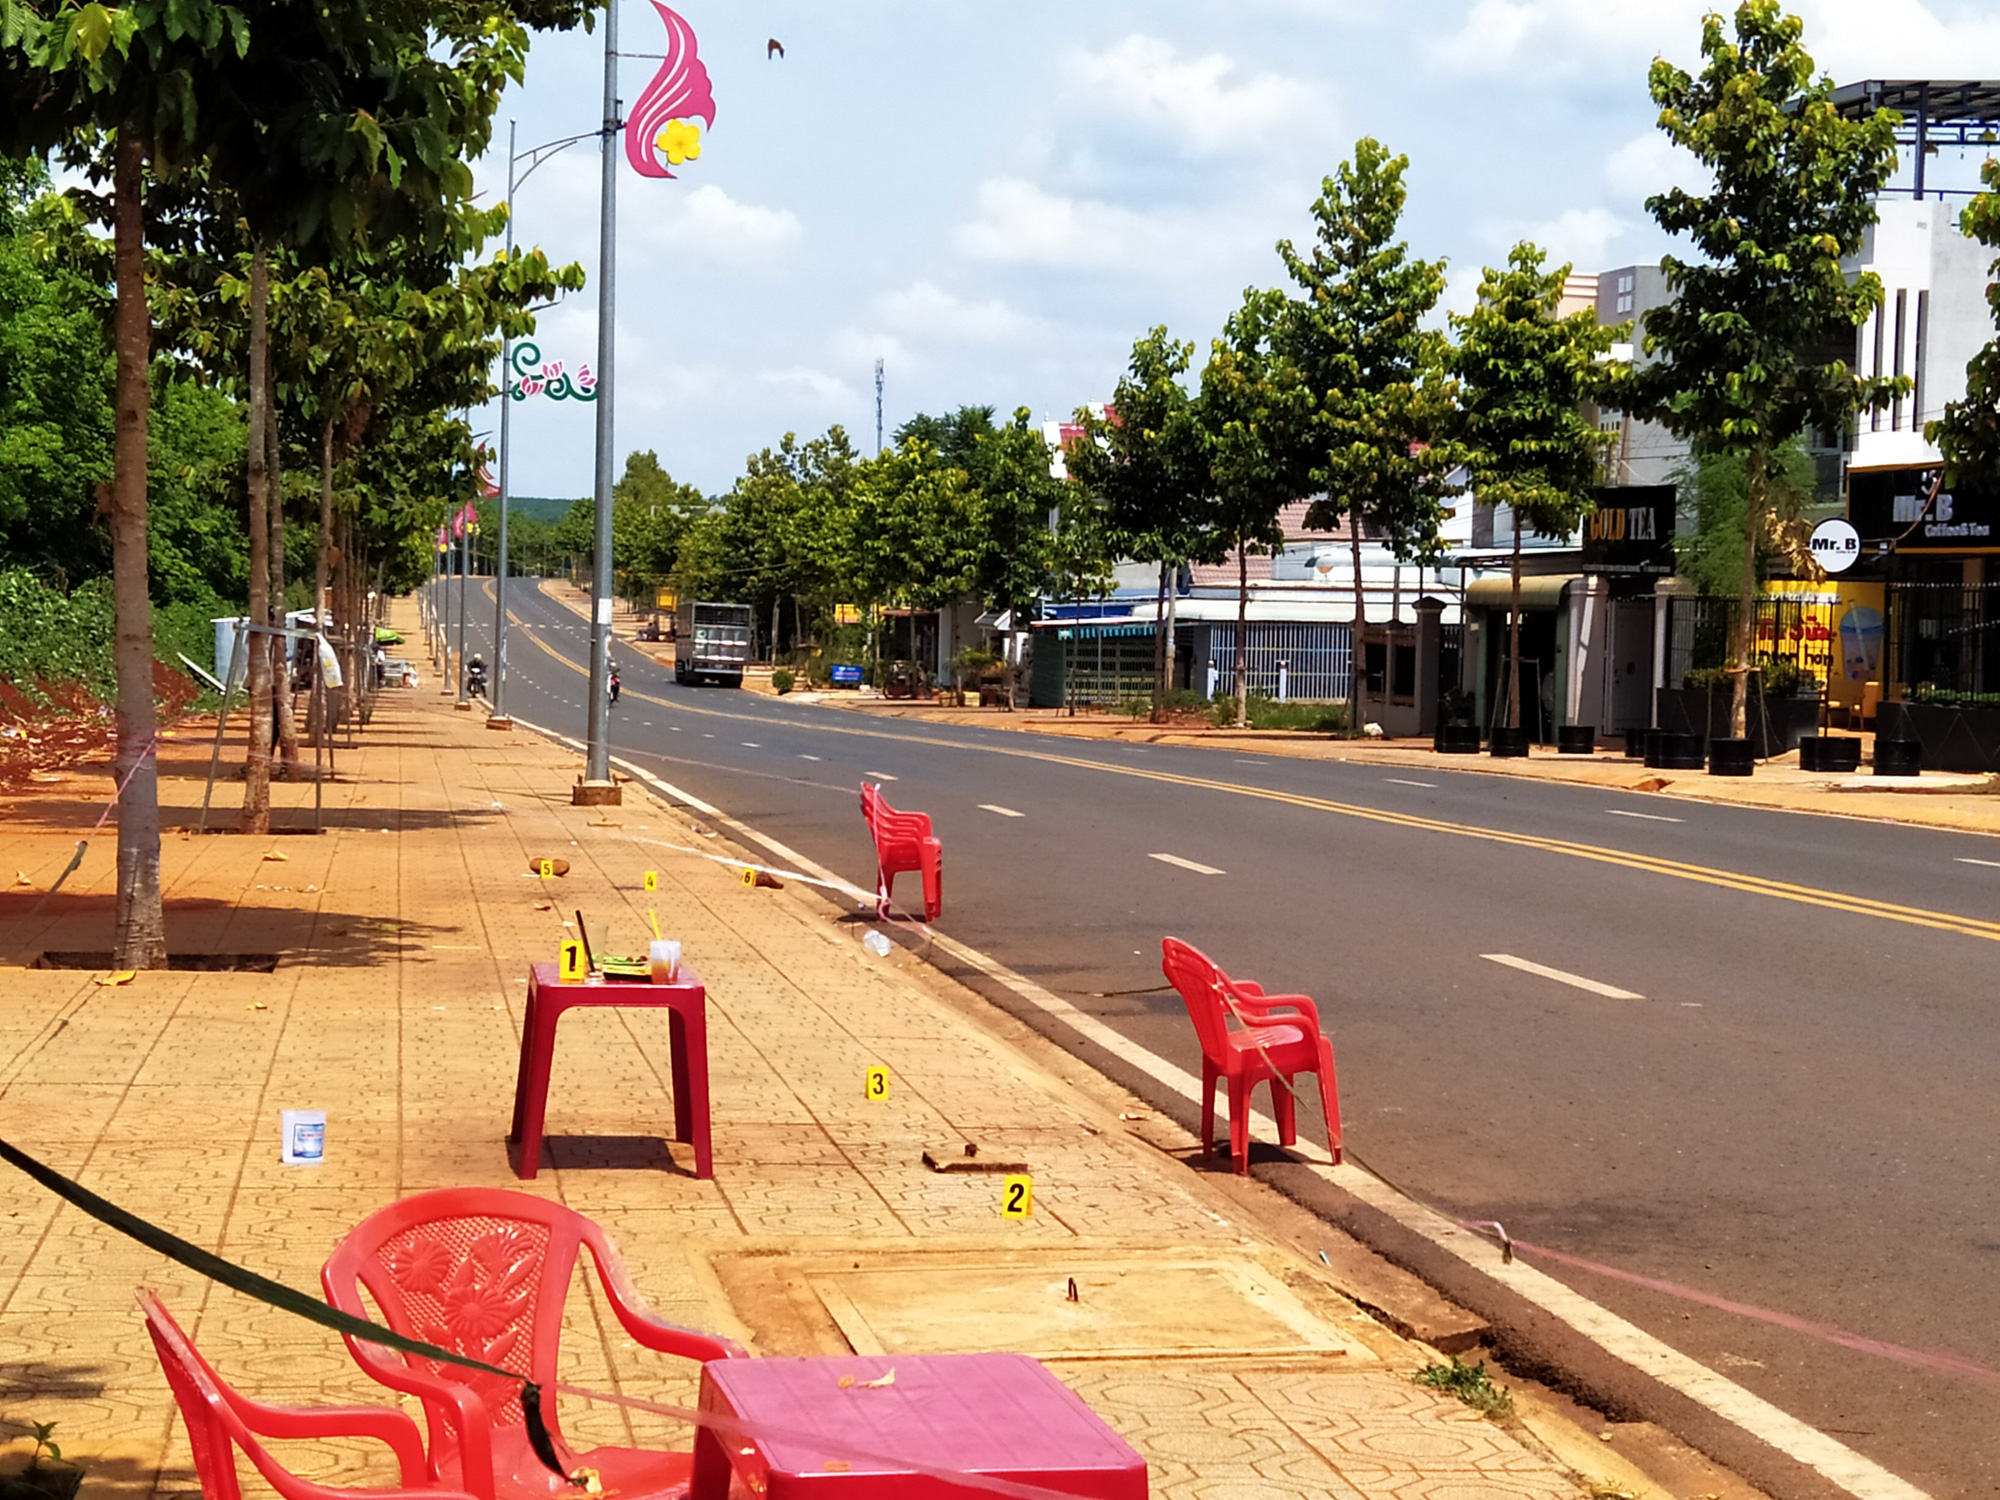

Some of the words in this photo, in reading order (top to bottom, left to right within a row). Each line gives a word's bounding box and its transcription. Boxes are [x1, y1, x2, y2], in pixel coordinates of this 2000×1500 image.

[1589, 507, 1626, 540] GOLD
[1628, 507, 1656, 540] TEA
[1812, 538, 1840, 550] Mr.
[1845, 538, 1856, 550] B
[543, 864, 551, 875] 5
[744, 871, 751, 883] 6
[647, 876, 654, 887] 4
[565, 945, 577, 972] 1
[873, 1073, 884, 1095] 3
[1007, 1183, 1024, 1213] 2
